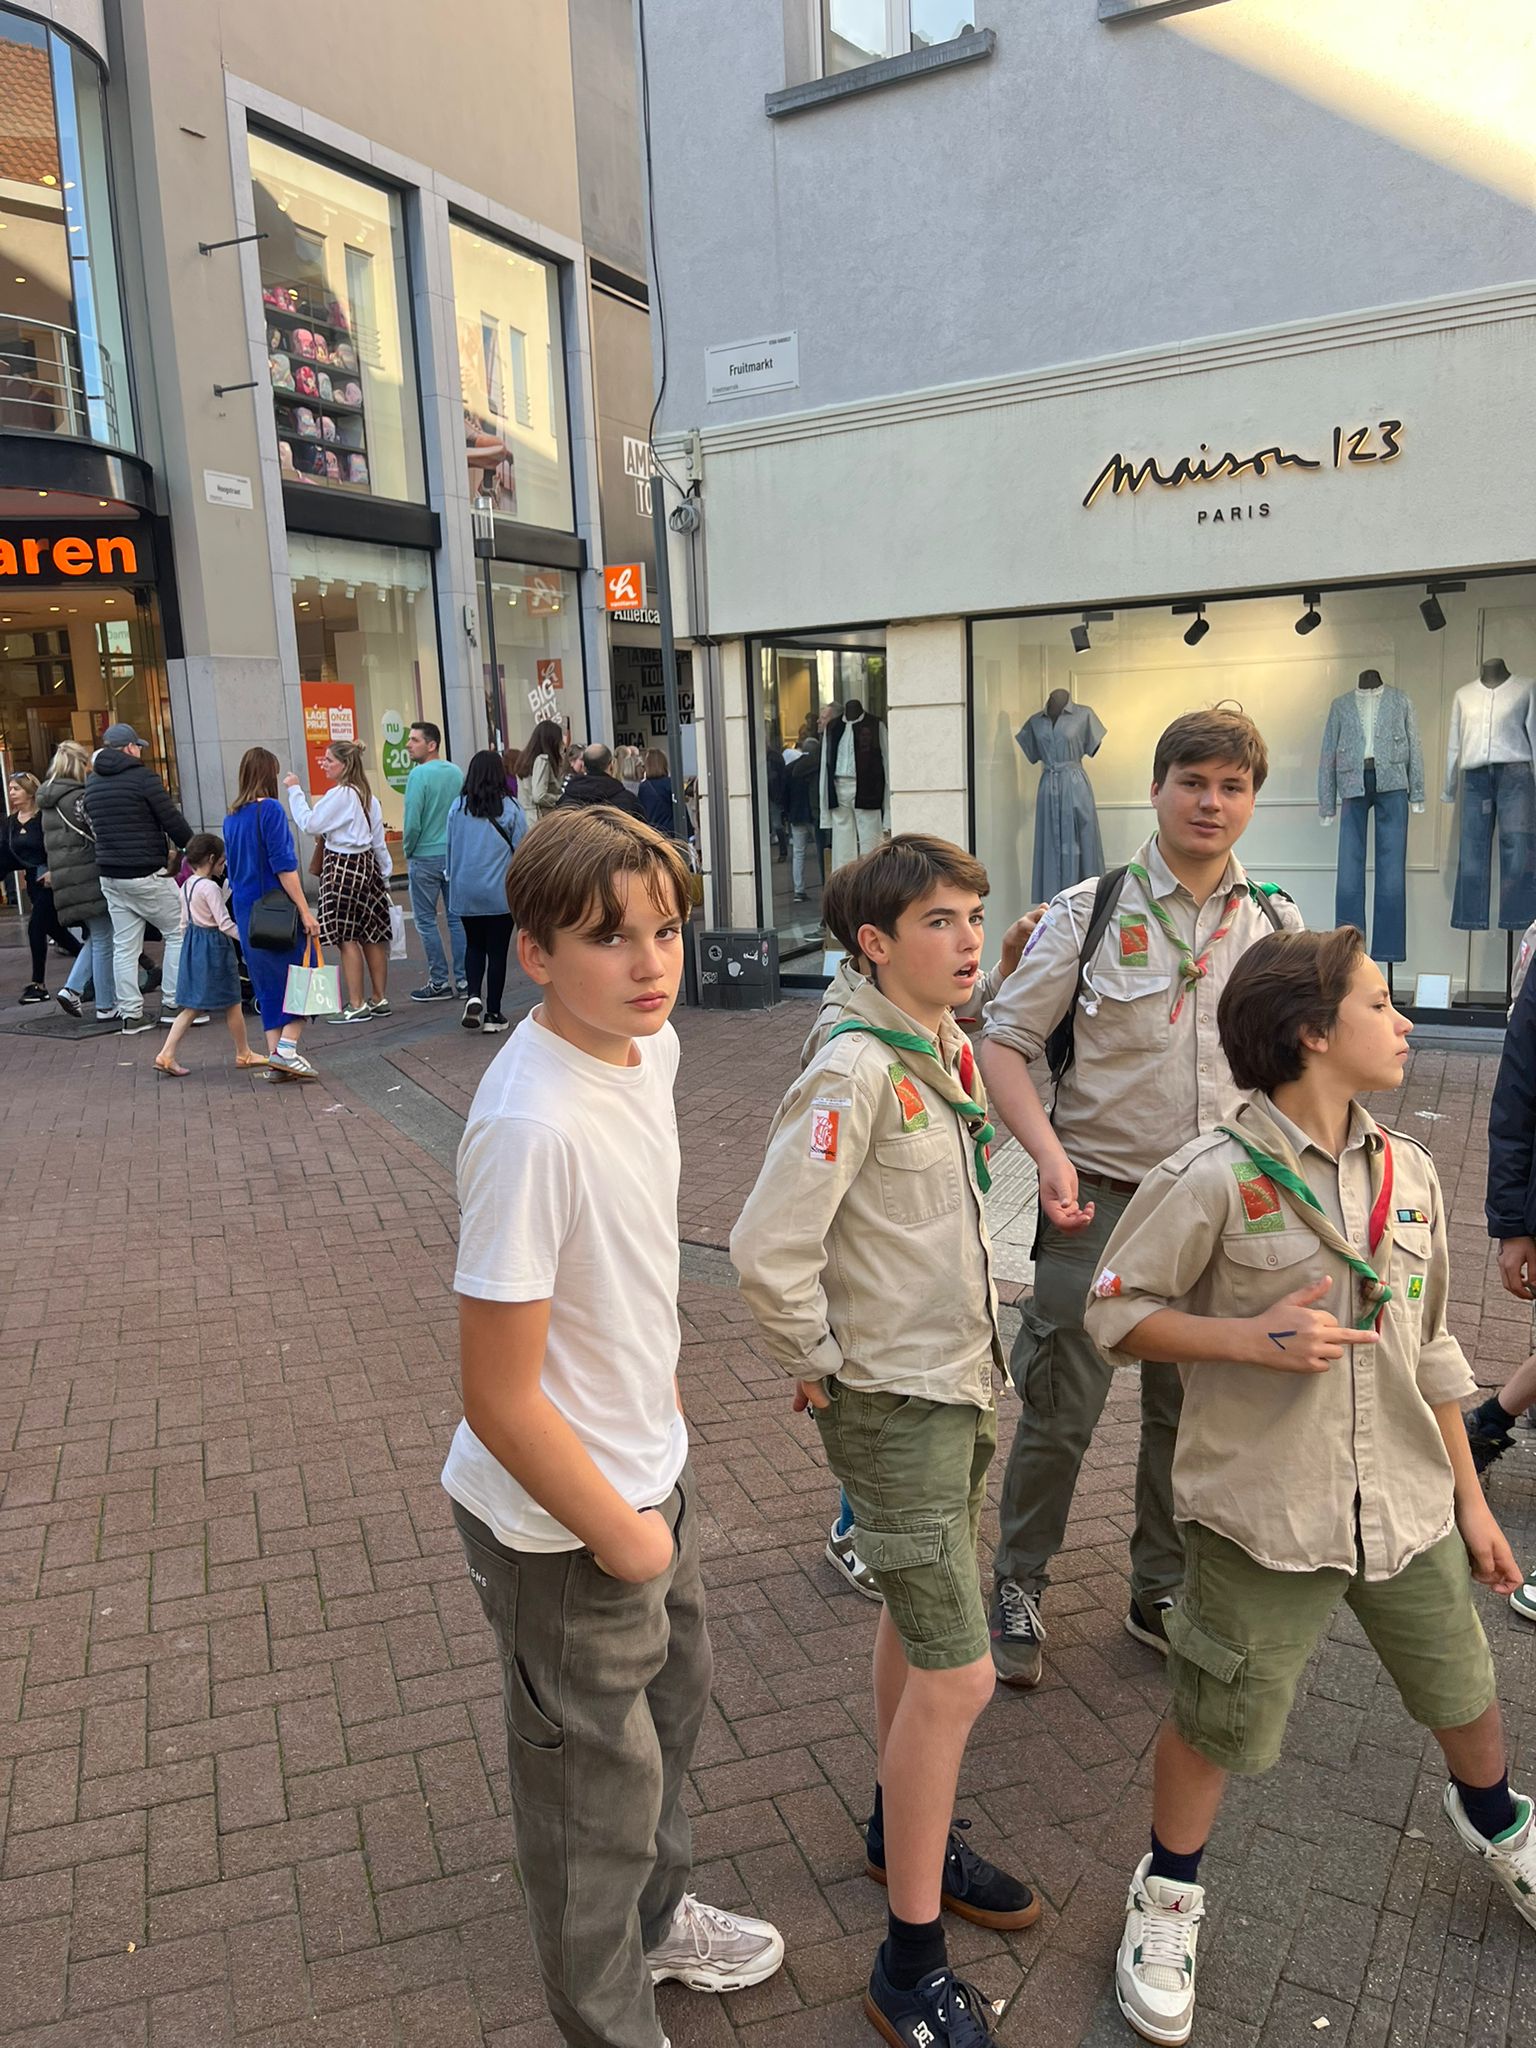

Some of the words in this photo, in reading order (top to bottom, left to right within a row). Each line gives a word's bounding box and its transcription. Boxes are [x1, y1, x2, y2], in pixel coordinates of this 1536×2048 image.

[729, 358, 773, 376] Fruitmarkt
[1082, 443, 1320, 508] Maison
[1333, 420, 1403, 468] 123
[1198, 503, 1271, 524] PARIS
[528, 678, 555, 712] BIG
[386, 722, 400, 733] nu
[386, 748, 416, 769] -20
